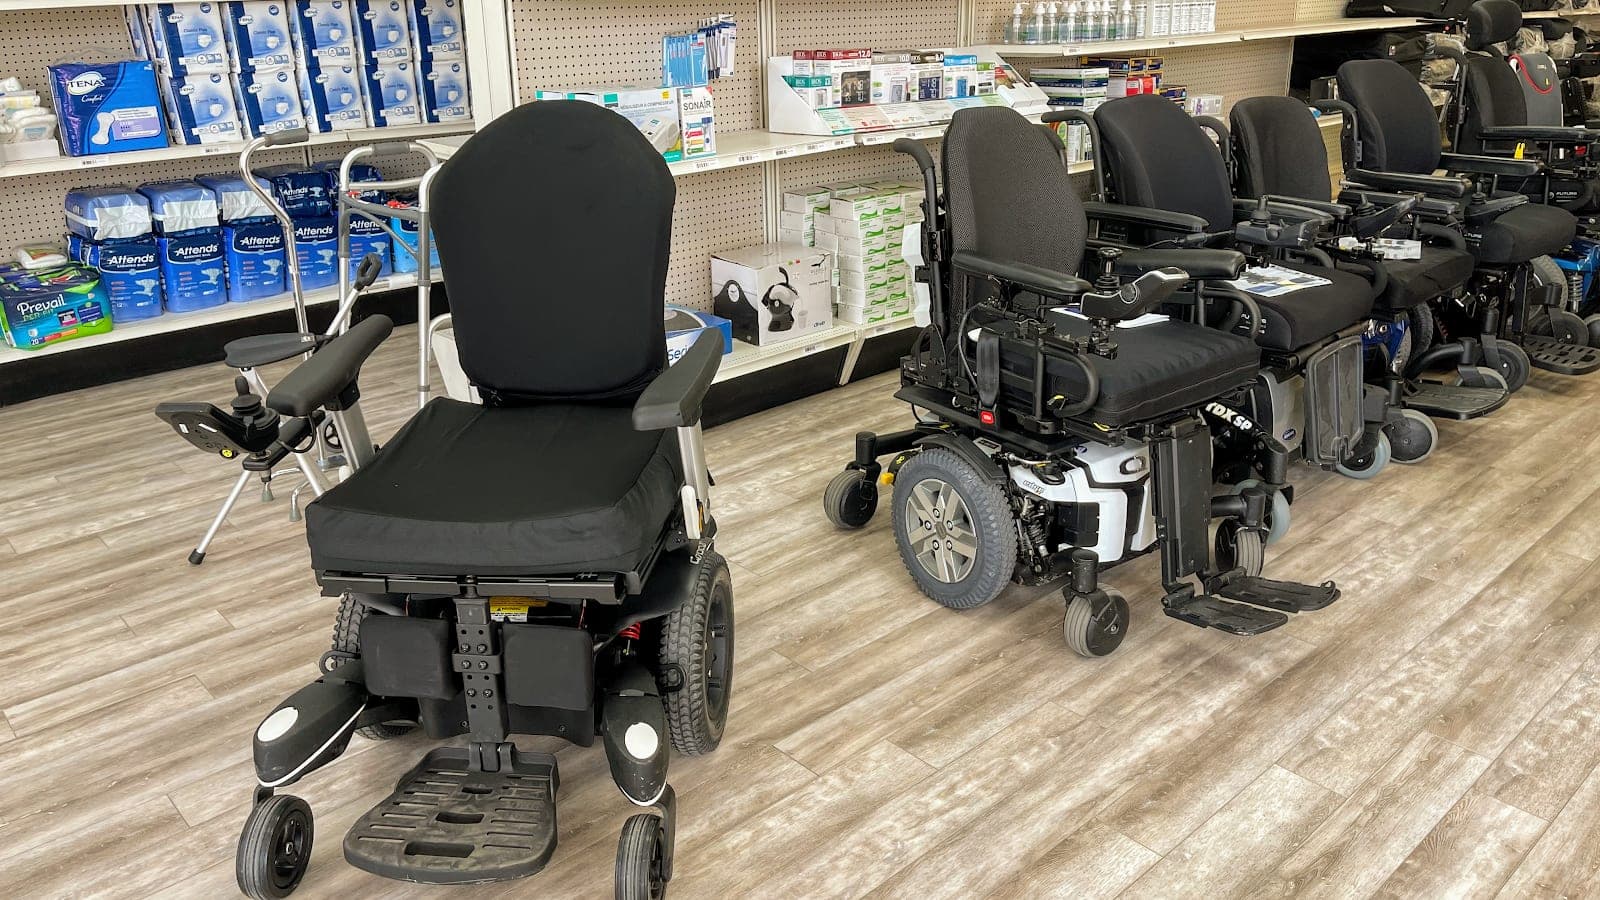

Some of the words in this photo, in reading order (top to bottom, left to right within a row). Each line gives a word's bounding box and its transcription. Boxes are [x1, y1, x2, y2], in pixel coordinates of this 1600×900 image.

[67, 78, 105, 88] TENA
[81, 94, 104, 104] Comfort
[294, 225, 334, 237] Attends
[239, 235, 280, 247] Attends
[173, 243, 218, 257] Attends
[107, 253, 155, 265] Attends
[16, 293, 67, 316] Prevail
[1205, 402, 1239, 424] TDX
[1233, 415, 1253, 430] SP
